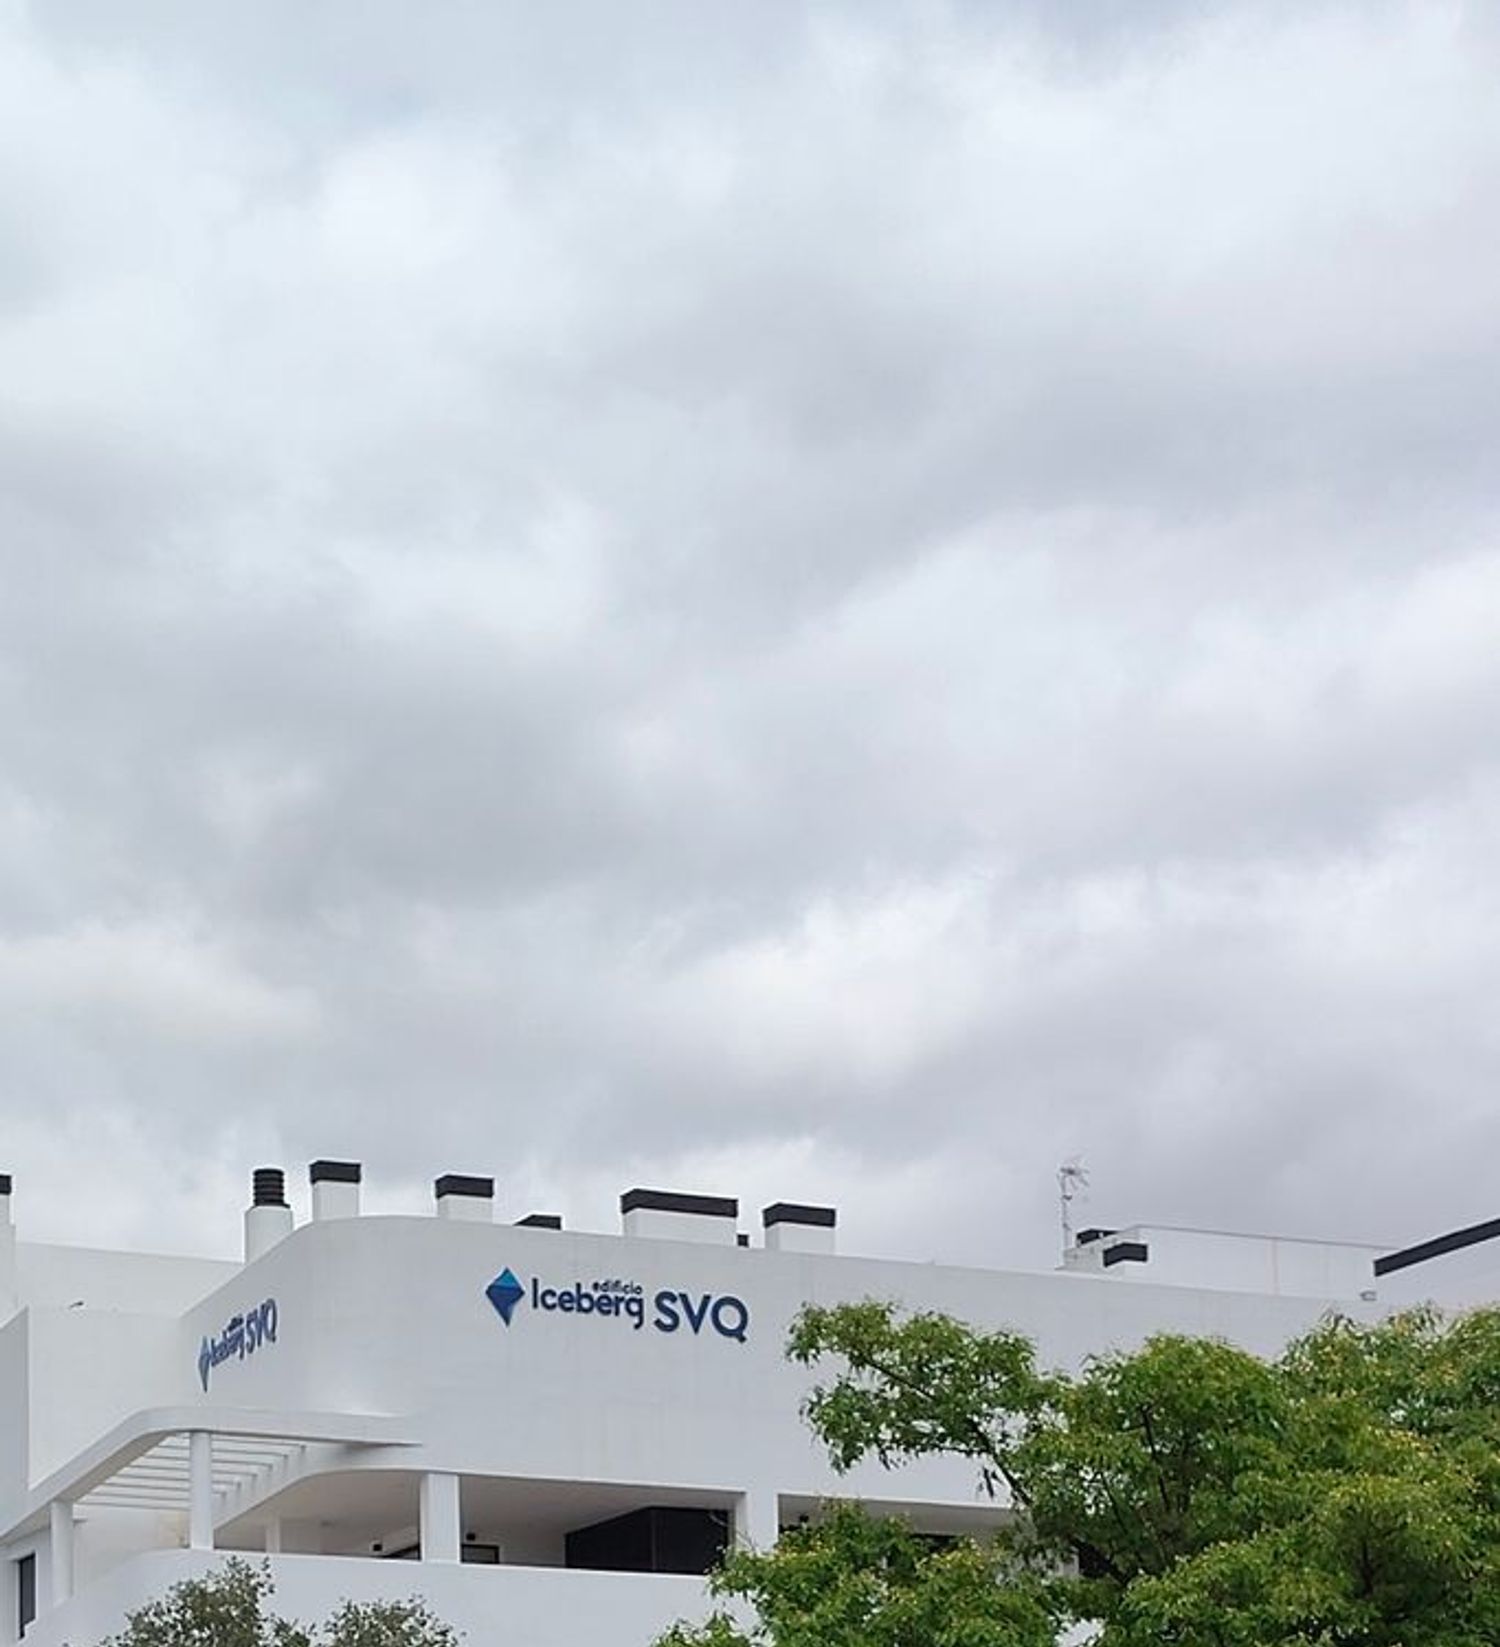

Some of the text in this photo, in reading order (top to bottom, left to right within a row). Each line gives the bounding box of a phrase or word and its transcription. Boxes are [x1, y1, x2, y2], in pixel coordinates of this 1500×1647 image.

[531, 1277, 748, 1343] Iceberg SVQ
[592, 1280, 643, 1295] edificio
[246, 1298, 277, 1354] SVQ
